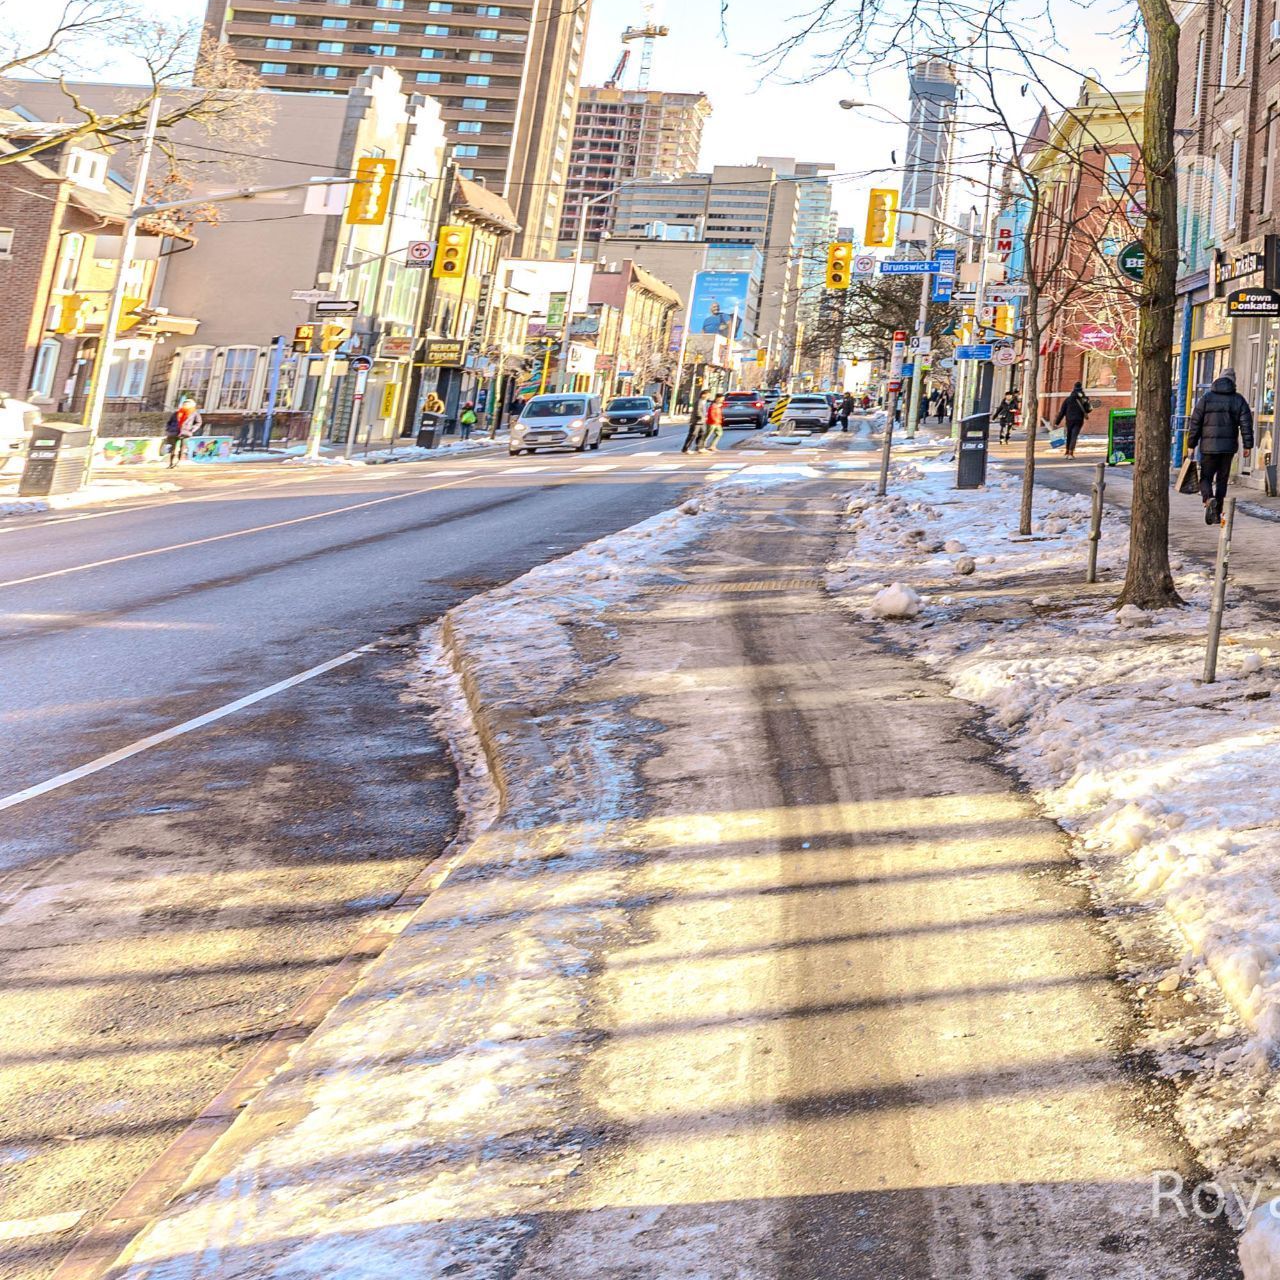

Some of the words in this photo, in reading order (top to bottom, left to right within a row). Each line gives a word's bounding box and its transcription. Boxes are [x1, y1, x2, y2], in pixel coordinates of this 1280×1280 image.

[882, 262, 930, 272] Brunswick
[986, 286, 1018, 295] Brunswick
[1238, 293, 1272, 302] Brown
[1230, 301, 1279, 310] Donkatsu
[430, 342, 461, 352] MEXICAN
[428, 351, 460, 361] CUISINE
